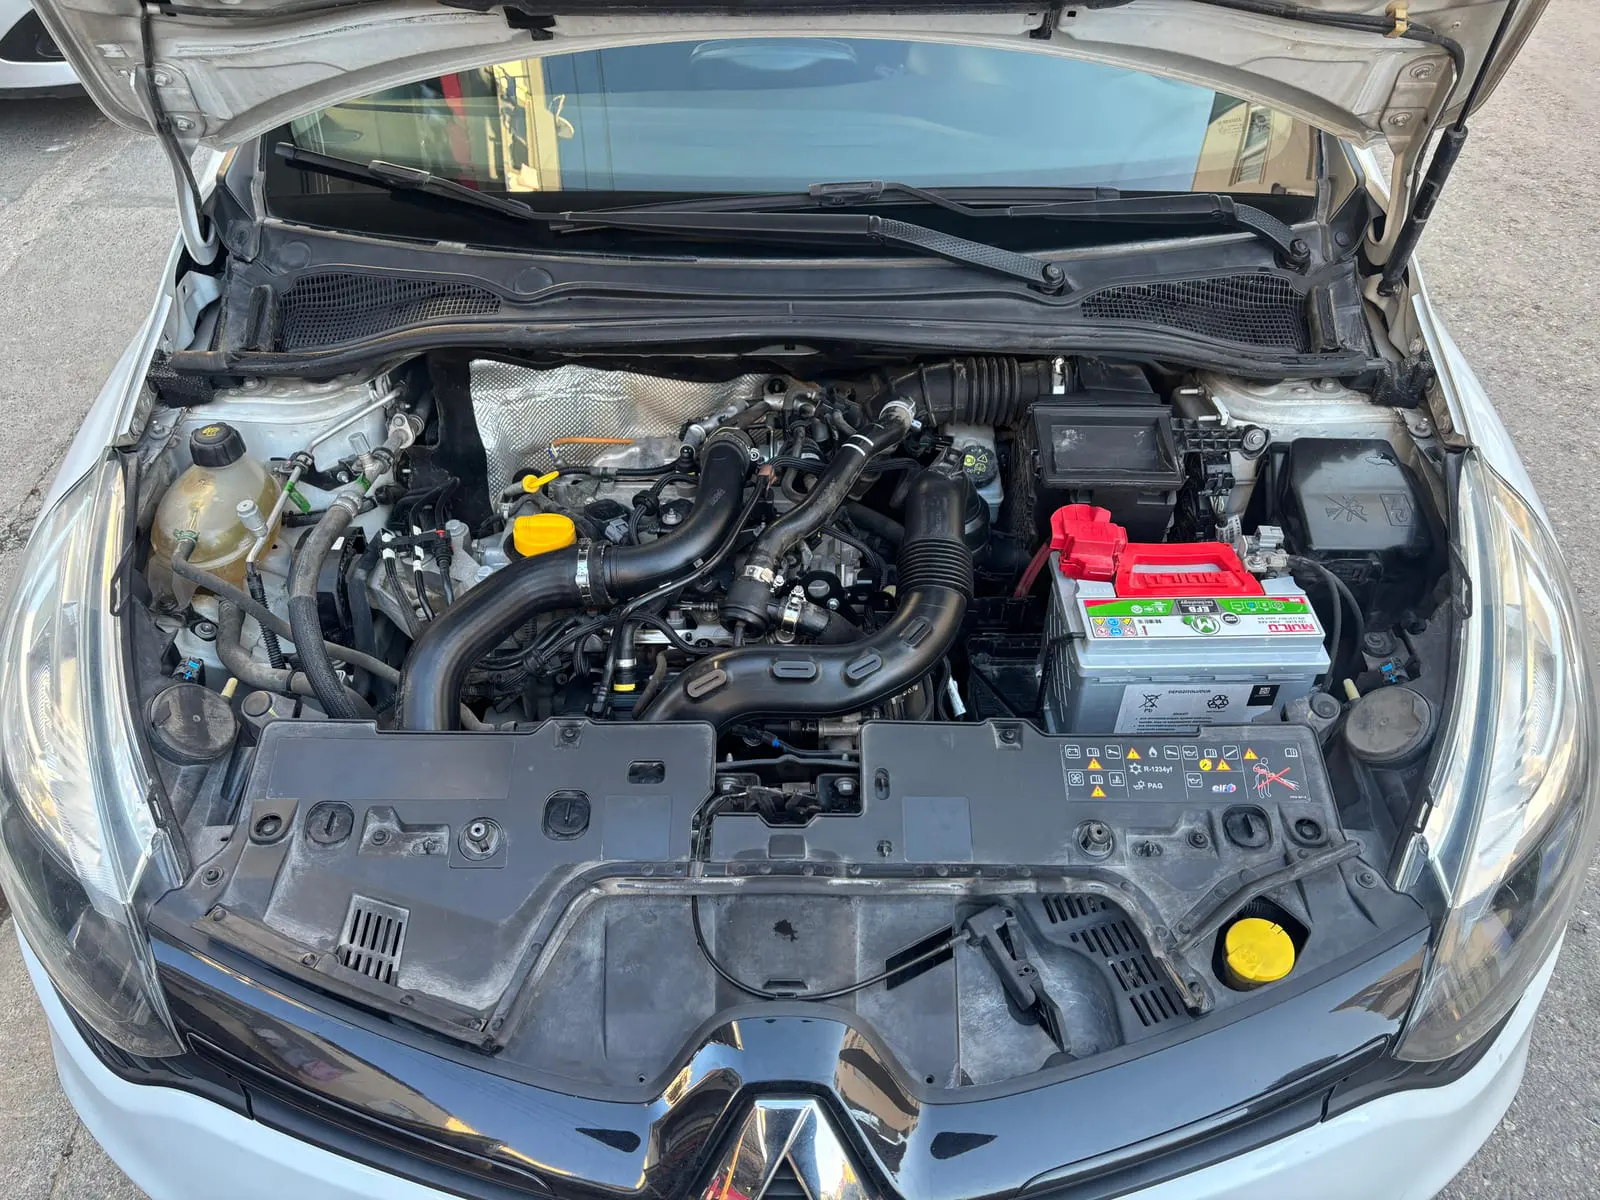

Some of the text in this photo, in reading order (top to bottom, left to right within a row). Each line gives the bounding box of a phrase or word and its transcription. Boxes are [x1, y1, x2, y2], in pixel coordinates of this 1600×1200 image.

[1268, 623, 1316, 633] MUTLU
[1143, 766, 1173, 774] R-1234yf
[1147, 782, 1164, 790] PAG
[1212, 784, 1229, 793] elf
